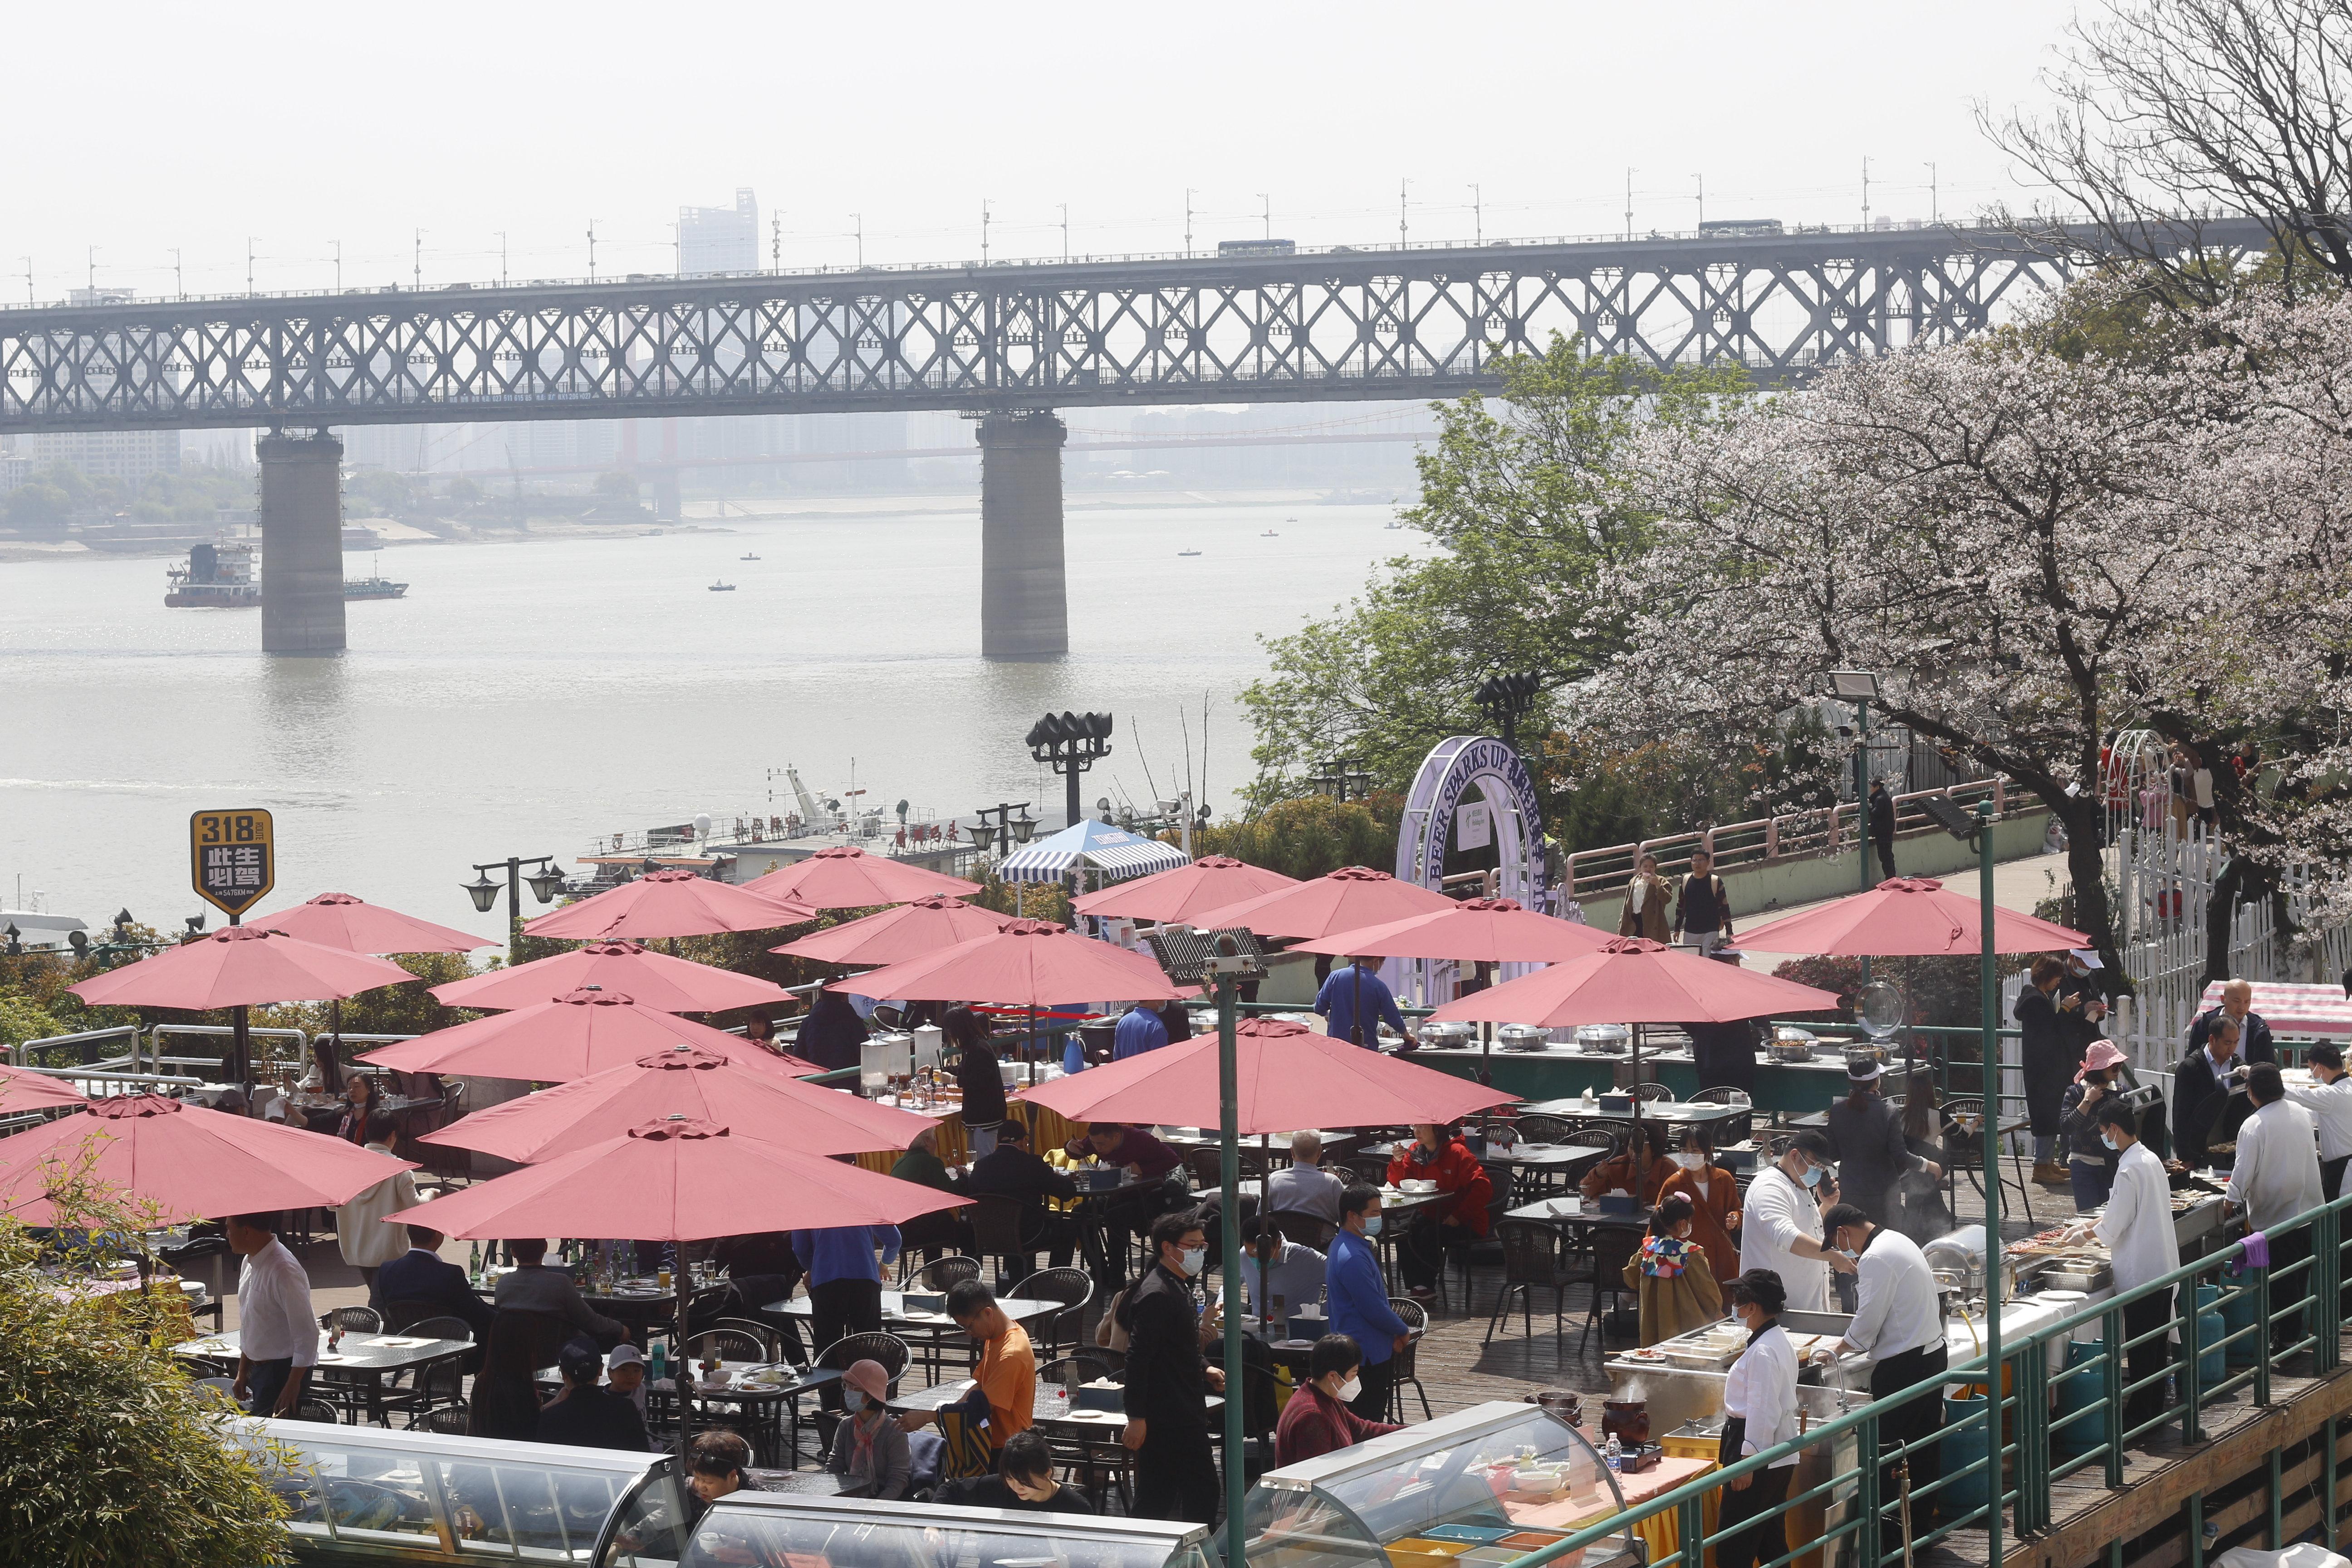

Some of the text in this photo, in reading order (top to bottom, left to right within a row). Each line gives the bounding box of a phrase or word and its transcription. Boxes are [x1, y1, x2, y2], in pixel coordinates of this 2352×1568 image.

[1430, 809, 1450, 882] BEER
[1444, 744, 1488, 810] SPARKS
[1490, 744, 1509, 771] UP
[202, 816, 254, 843] 318
[255, 822, 264, 841] ROUTE
[208, 847, 260, 867] 此生
[208, 867, 260, 887] 必驾
